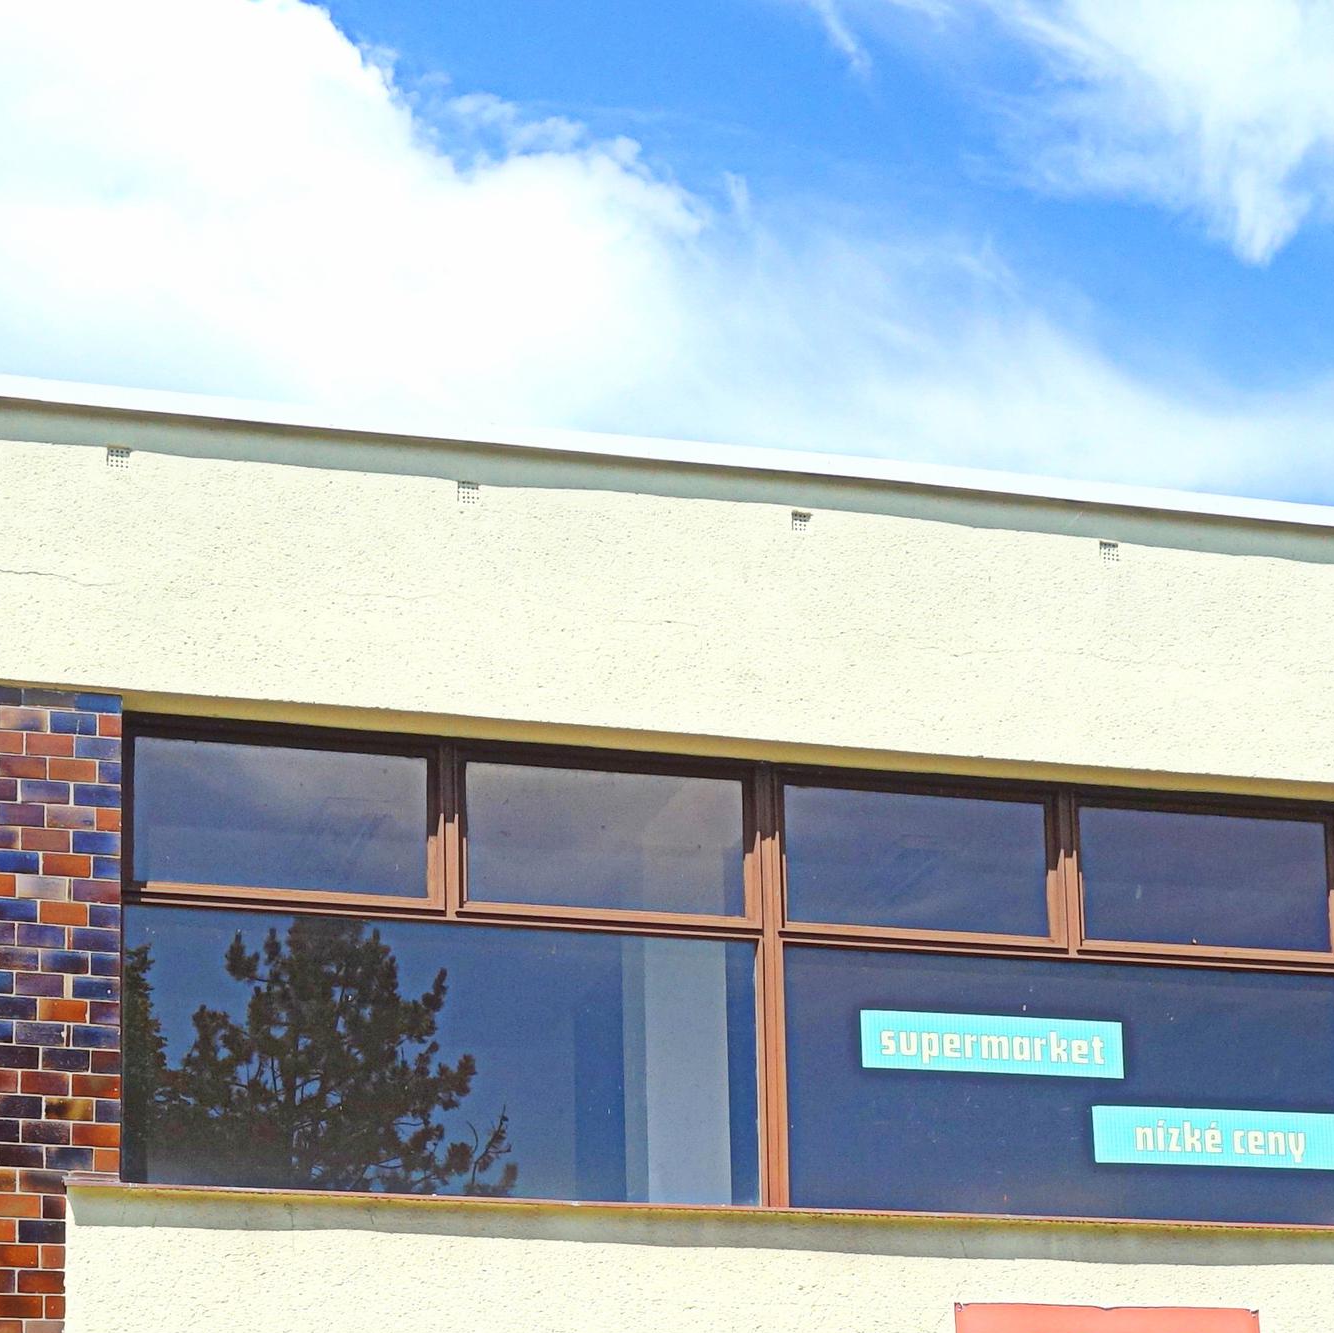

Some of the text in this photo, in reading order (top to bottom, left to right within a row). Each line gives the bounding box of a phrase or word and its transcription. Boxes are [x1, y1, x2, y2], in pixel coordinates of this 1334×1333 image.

[880, 1029, 1105, 1064] supermarket
[1134, 1119, 1307, 1164] nízké ceny
